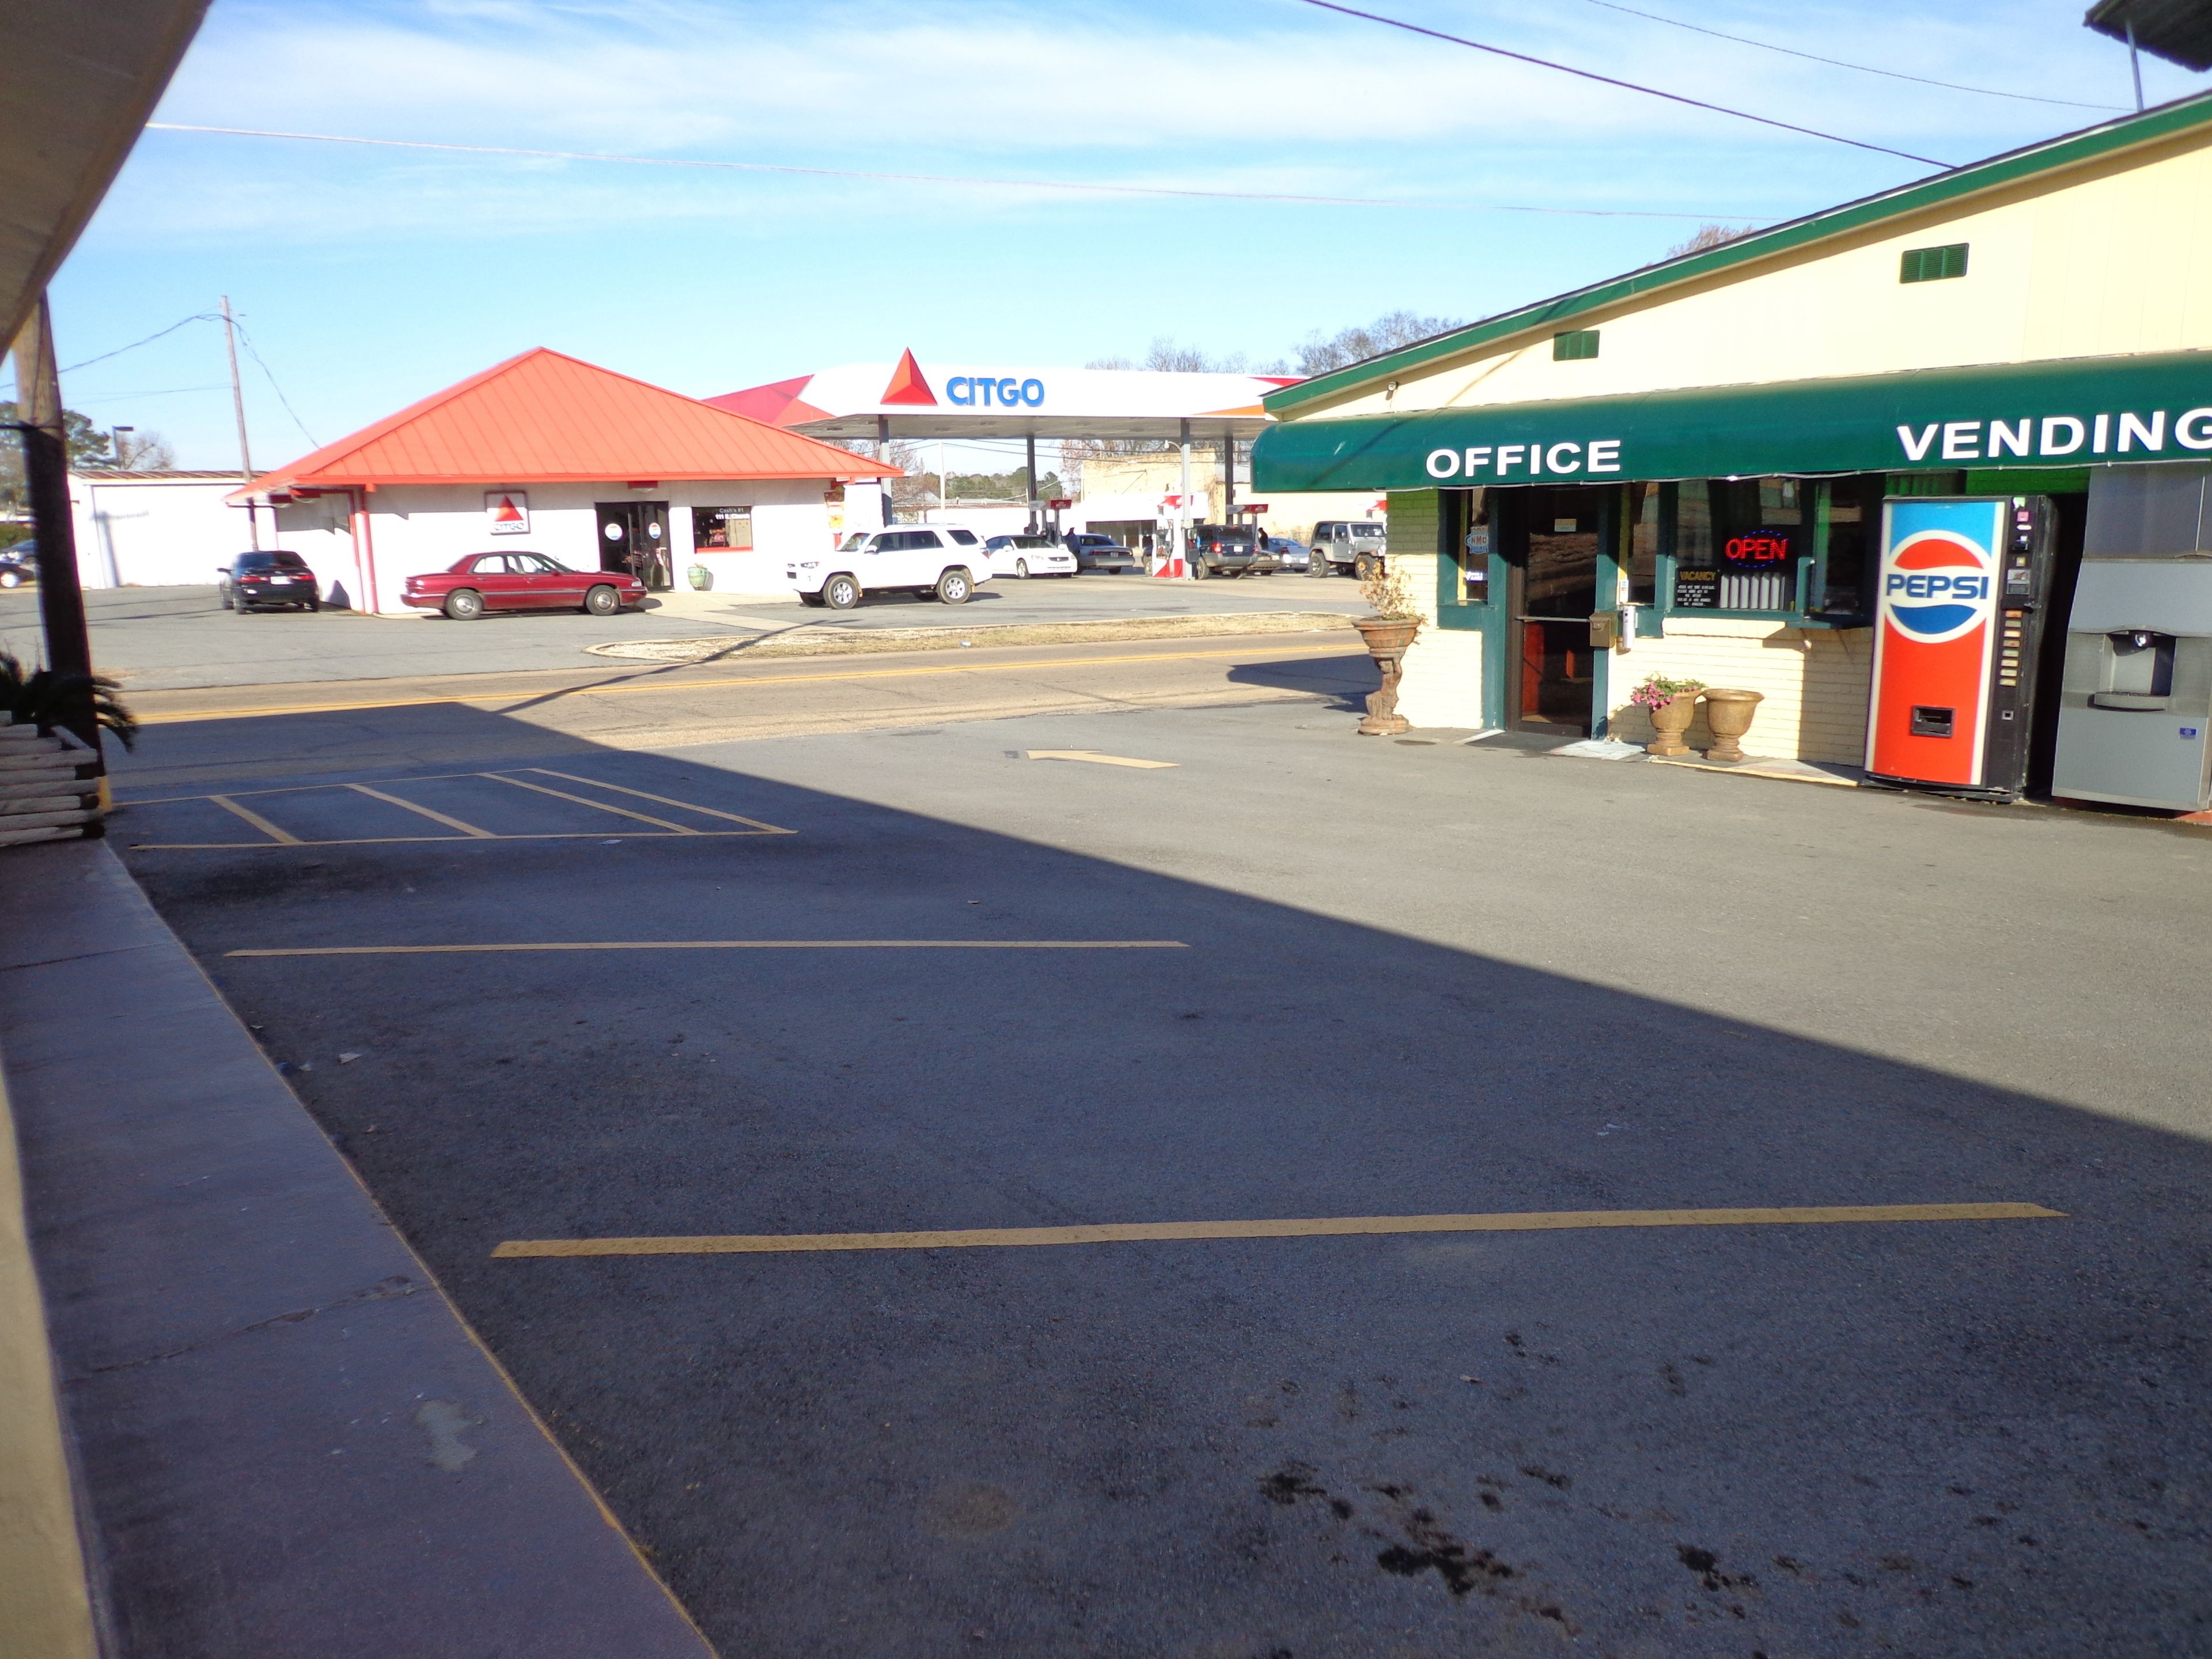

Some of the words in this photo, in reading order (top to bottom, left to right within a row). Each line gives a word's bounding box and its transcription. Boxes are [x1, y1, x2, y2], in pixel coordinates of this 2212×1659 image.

[946, 376, 1045, 407] CITGO
[1896, 407, 2212, 461] VENDING
[1426, 440, 1622, 479] OFFICE
[1725, 538, 1787, 559] OPEN
[1680, 571, 1716, 581] VACANCY
[1886, 574, 1989, 600] PEPSI
